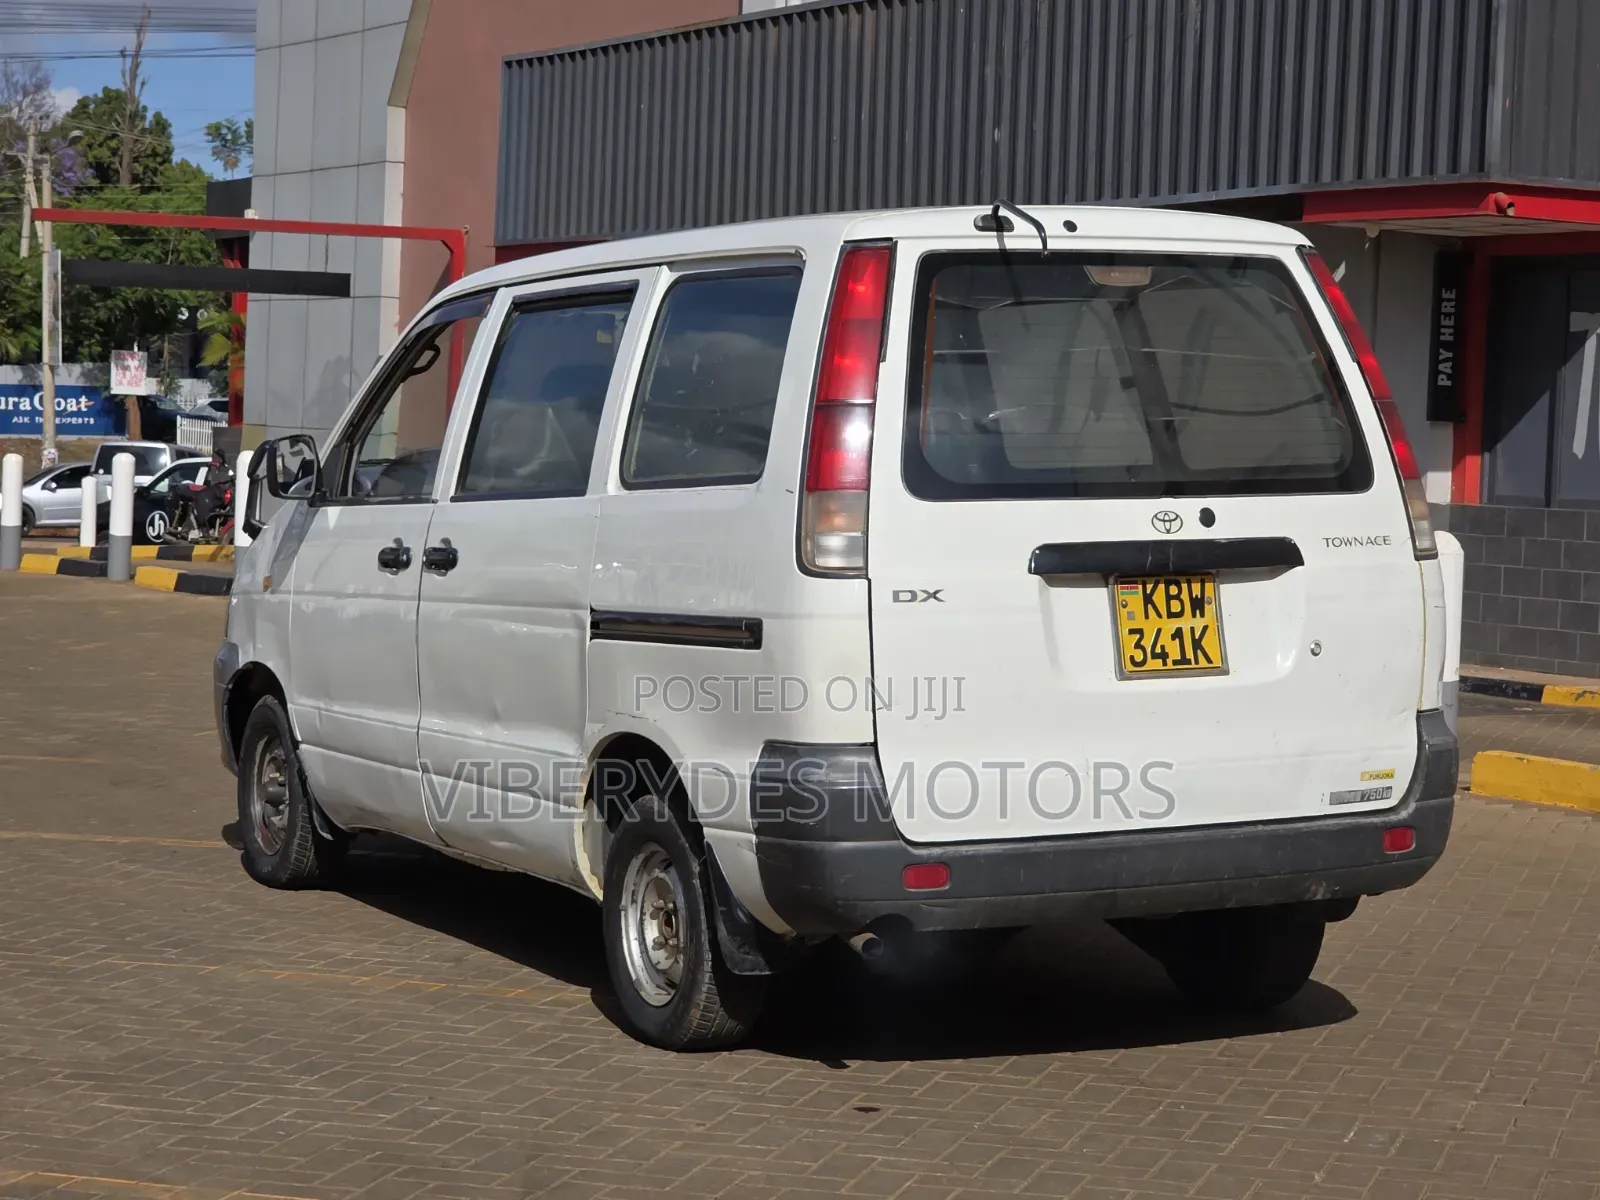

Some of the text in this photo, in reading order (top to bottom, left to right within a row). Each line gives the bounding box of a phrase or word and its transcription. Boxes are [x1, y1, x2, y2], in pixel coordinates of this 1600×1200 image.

[1437, 287, 1456, 387] PAY HERE
[12, 416, 30, 424] ASK
[1322, 535, 1392, 548] TOWNACE
[892, 589, 946, 603] DX
[1142, 578, 1206, 620] KBW
[1127, 624, 1214, 668] 341K
[1370, 772, 1394, 780] FUKUOKA
